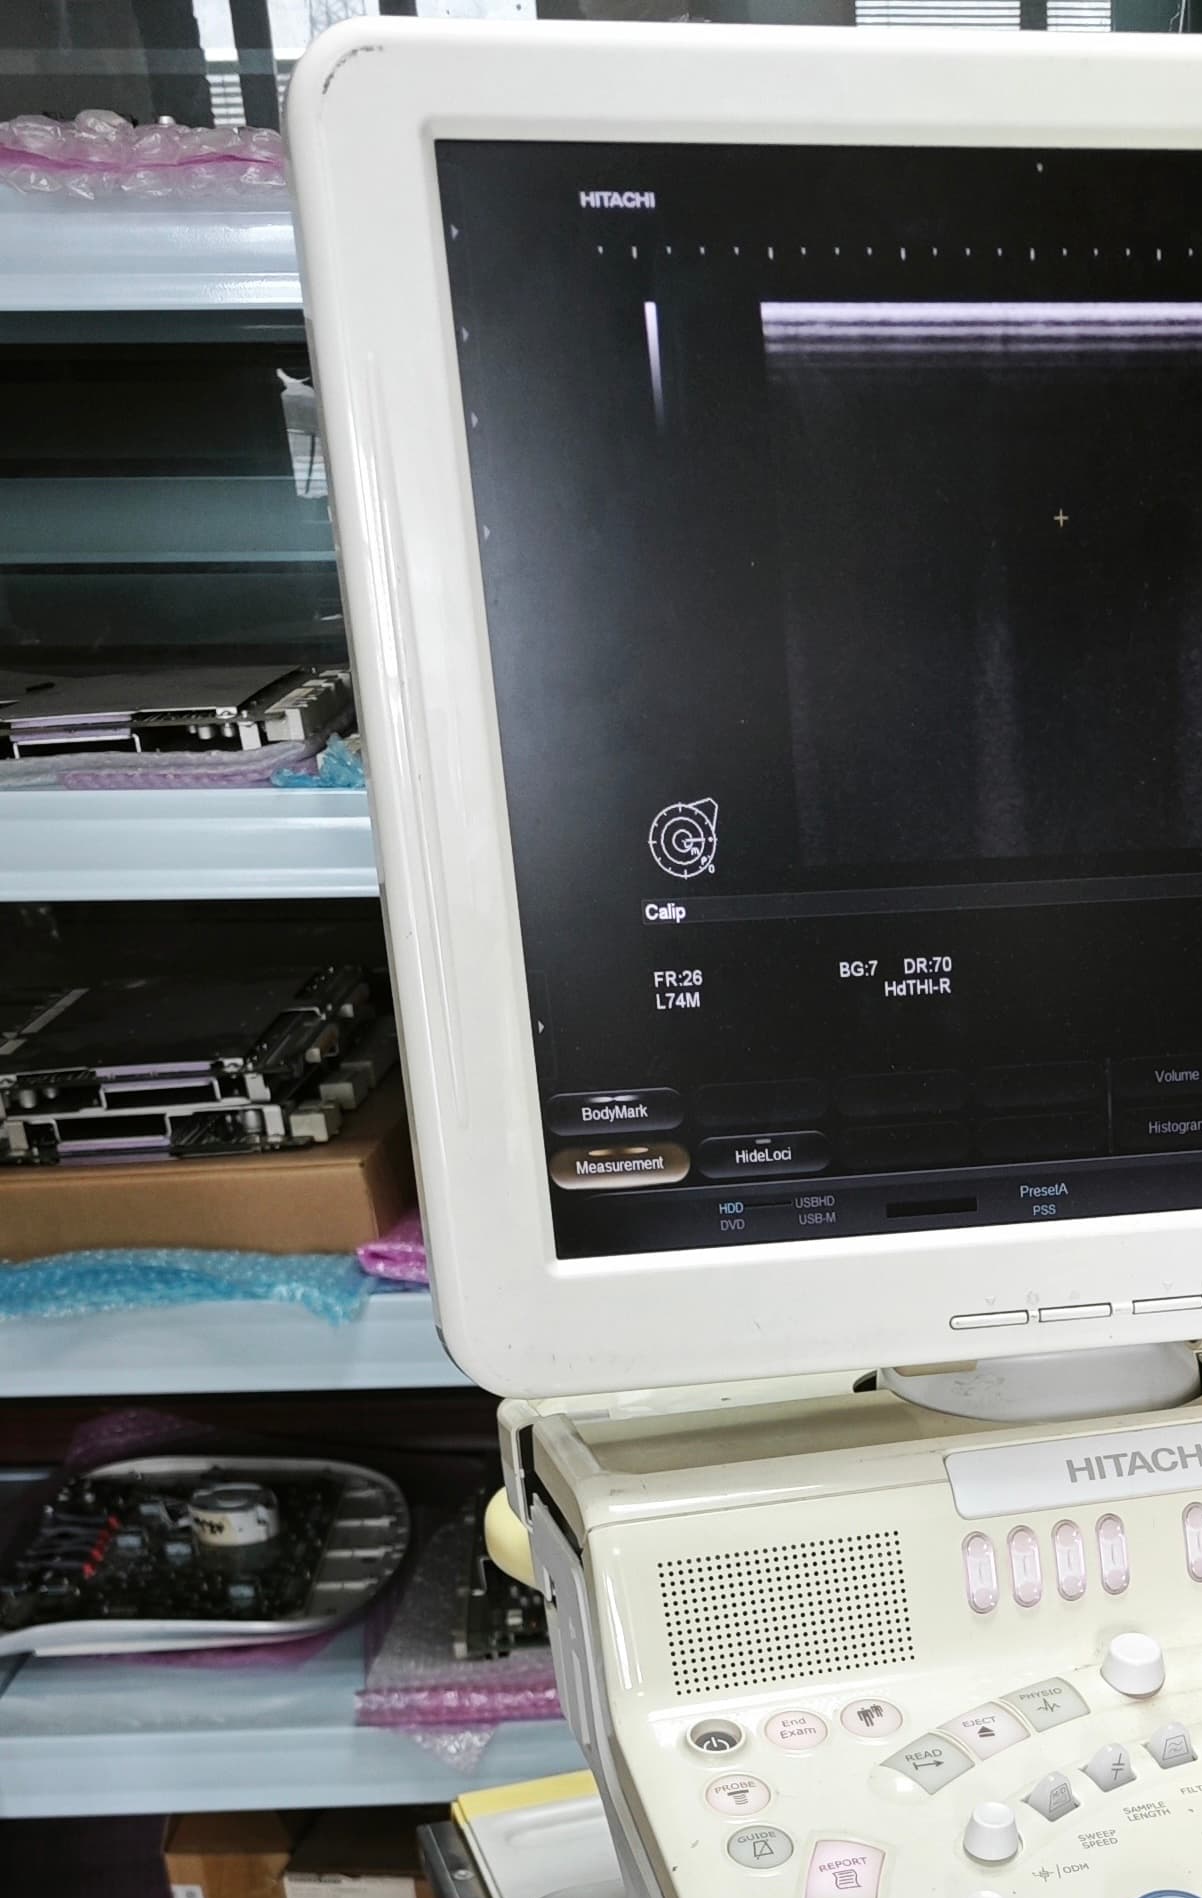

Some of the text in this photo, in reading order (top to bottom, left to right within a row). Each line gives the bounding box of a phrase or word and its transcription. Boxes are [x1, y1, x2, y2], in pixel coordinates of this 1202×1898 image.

[579, 191, 656, 209] HITACHI
[644, 903, 687, 923] Calip
[838, 956, 953, 977] BG:7 DR:70
[653, 969, 704, 988] FR:26
[655, 992, 701, 1011] L74M
[1154, 1067, 1200, 1084] Volume
[581, 1103, 649, 1123] BodyMark
[734, 1146, 793, 1165] HideLoci
[575, 1155, 665, 1175] Measurement
[1019, 1183, 1069, 1199] PresetA
[719, 1202, 745, 1216] HDD
[794, 1194, 836, 1210] USBHD
[1032, 1203, 1057, 1217] PSS
[719, 1217, 746, 1232] DVD
[798, 1211, 838, 1227] USB-M
[781, 1717, 807, 1728] End
[961, 1716, 997, 1728] EJECT
[779, 1726, 817, 1739] Exam
[904, 1748, 944, 1763] READ
[714, 1780, 756, 1793] PROBE
[1122, 1800, 1167, 1815] SAMPLE
[1126, 1808, 1172, 1822] LENGTH
[736, 1831, 777, 1843] GUIDE
[1077, 1828, 1117, 1843] SWEEP
[1081, 1836, 1120, 1850] SPEED
[818, 1856, 868, 1872] REPORT
